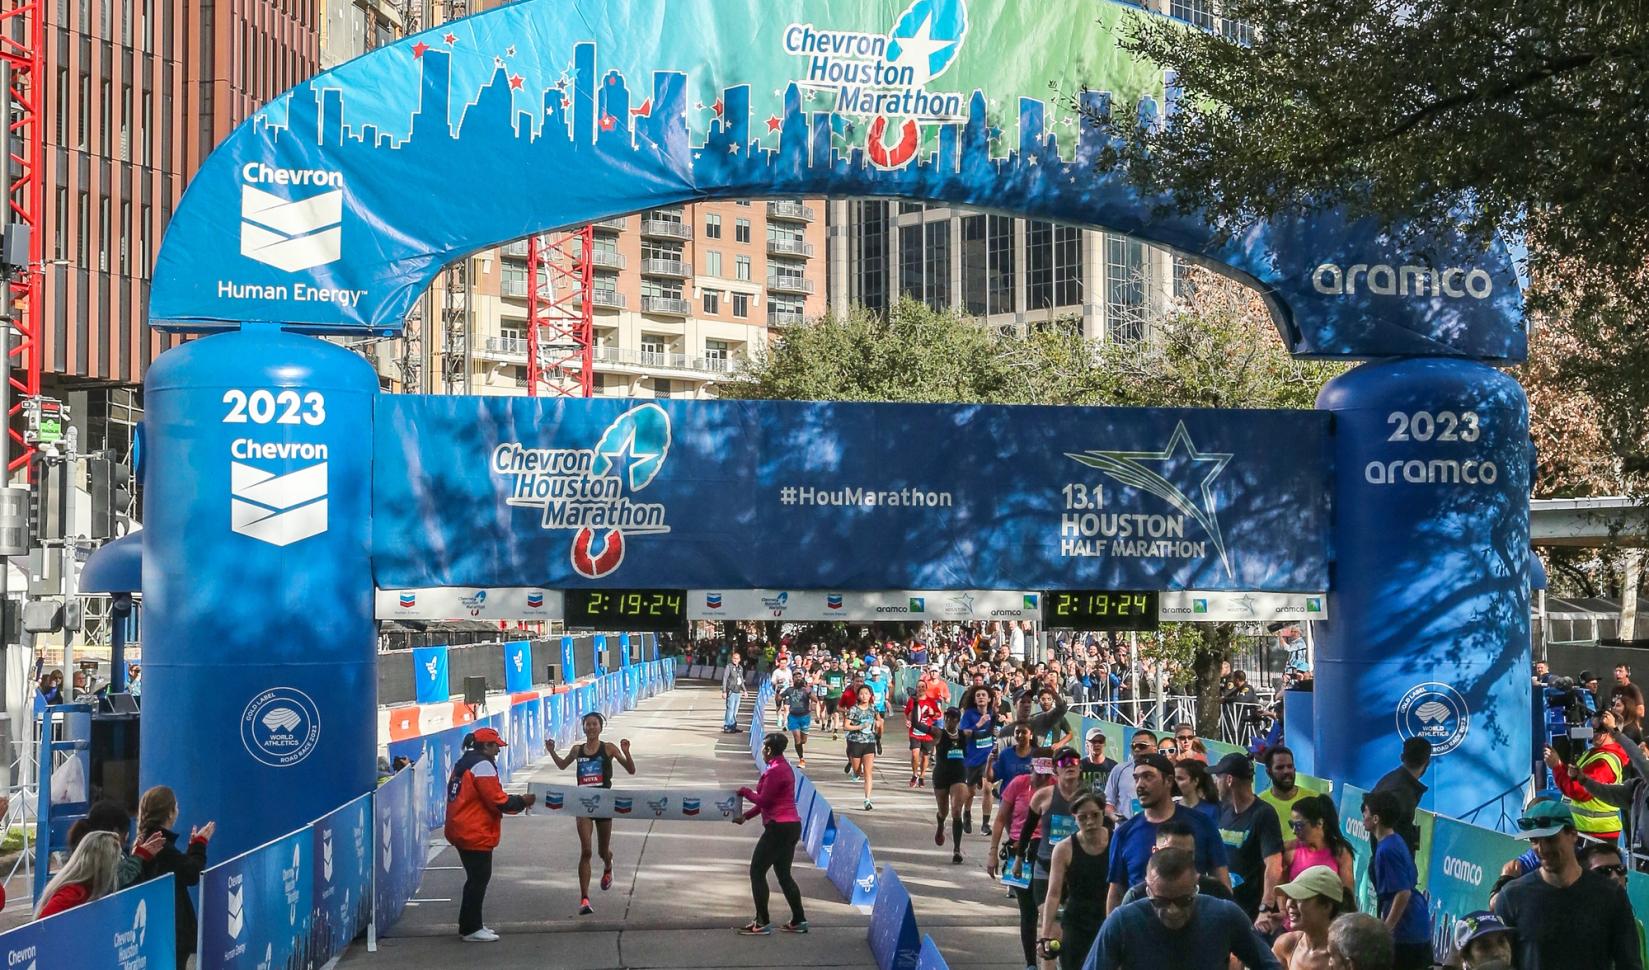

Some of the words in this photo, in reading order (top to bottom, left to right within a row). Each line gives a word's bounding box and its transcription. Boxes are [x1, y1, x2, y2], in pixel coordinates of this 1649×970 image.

[786, 26, 885, 57] Chevron
[810, 55, 914, 86] Houston
[838, 85, 961, 116] Marathon
[242, 162, 344, 187] Chevron
[217, 280, 288, 300] Human
[1312, 263, 1493, 299] aramco
[222, 389, 326, 426] 2023
[1387, 410, 1480, 442] 2023
[231, 438, 328, 460] Chevron
[495, 446, 591, 471] Chevron
[1364, 459, 1498, 485] aramco
[518, 473, 619, 499] Houston
[780, 486, 952, 507] #HouMarathon
[1062, 483, 1104, 510] 13.1
[545, 501, 663, 526] Marathon
[1061, 513, 1184, 538] HOUSTON
[1061, 539, 1107, 557] HALF
[1111, 540, 1206, 559] MARATHON
[246, 704, 258, 721] GOLD
[256, 692, 276, 706] LABEL
[280, 754, 299, 763] ROAD
[298, 742, 312, 757] RACE
[1443, 855, 1483, 887] aramco
[114, 929, 135, 948] Chevron
[8, 945, 37, 966] Chevron
